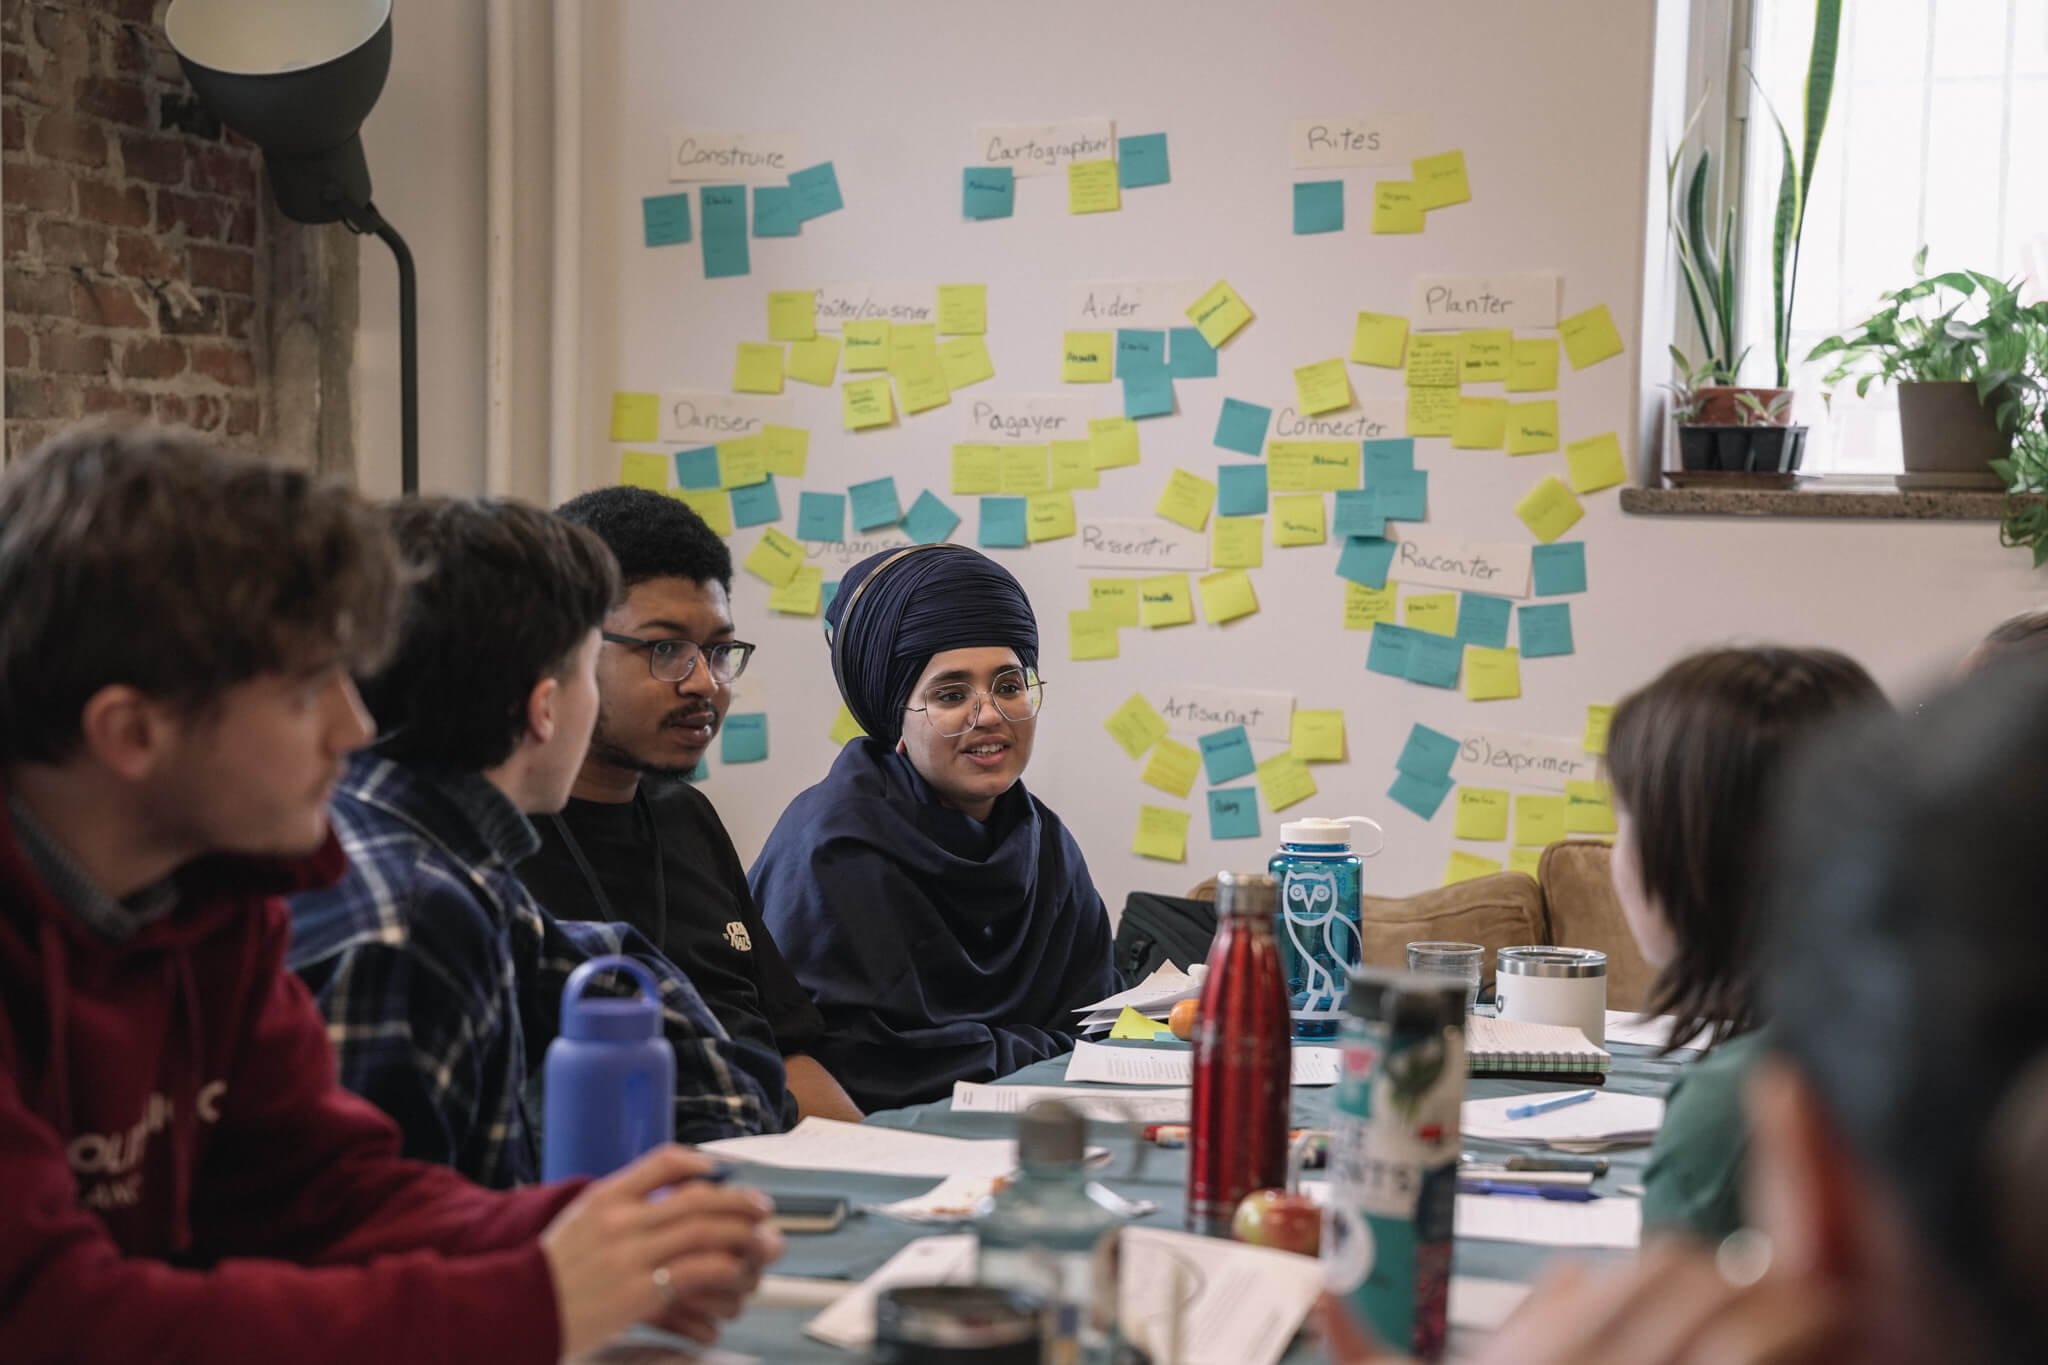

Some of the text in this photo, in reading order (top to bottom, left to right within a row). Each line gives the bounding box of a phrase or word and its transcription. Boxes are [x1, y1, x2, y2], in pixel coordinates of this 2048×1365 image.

[677, 137, 786, 169] Construire
[1308, 125, 1381, 151] Rites
[1081, 292, 1141, 318] Aider
[1425, 285, 1514, 315] Planter
[673, 401, 760, 432] Danser
[973, 401, 1067, 438] Pagayer
[1275, 407, 1388, 437] Connecter
[1082, 525, 1179, 556] Ressentir
[1400, 541, 1501, 580] Raconter
[1162, 696, 1265, 727] Artisanat
